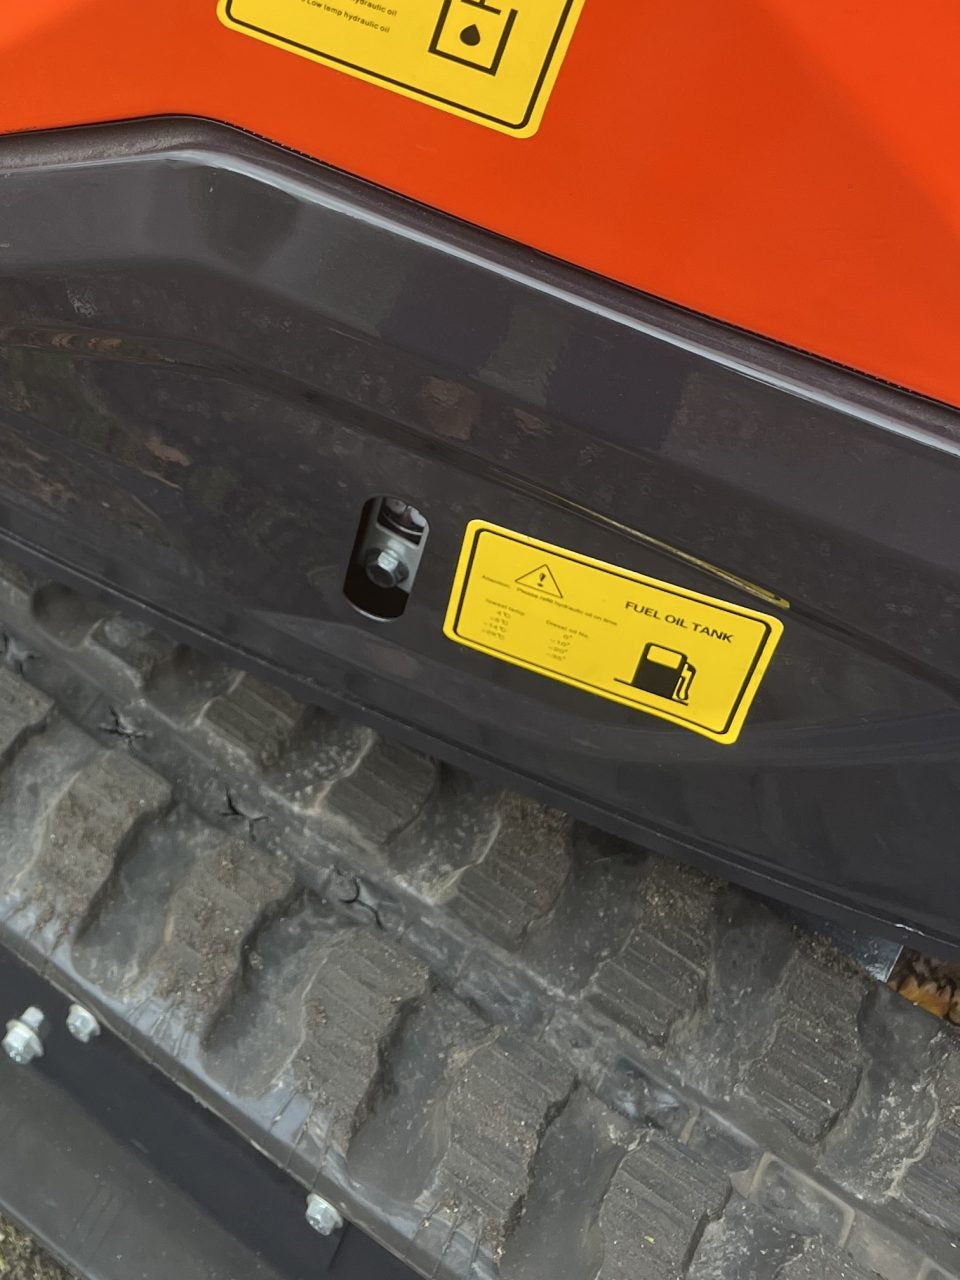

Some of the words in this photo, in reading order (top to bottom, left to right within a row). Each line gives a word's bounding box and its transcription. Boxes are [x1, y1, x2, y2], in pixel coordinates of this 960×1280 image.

[343, 11, 379, 30] hydraulic
[379, 26, 390, 34] oil
[386, 9, 397, 17] oil
[625, 601, 661, 620] FUEL
[664, 614, 688, 629] OIL
[691, 622, 734, 644] TANK
